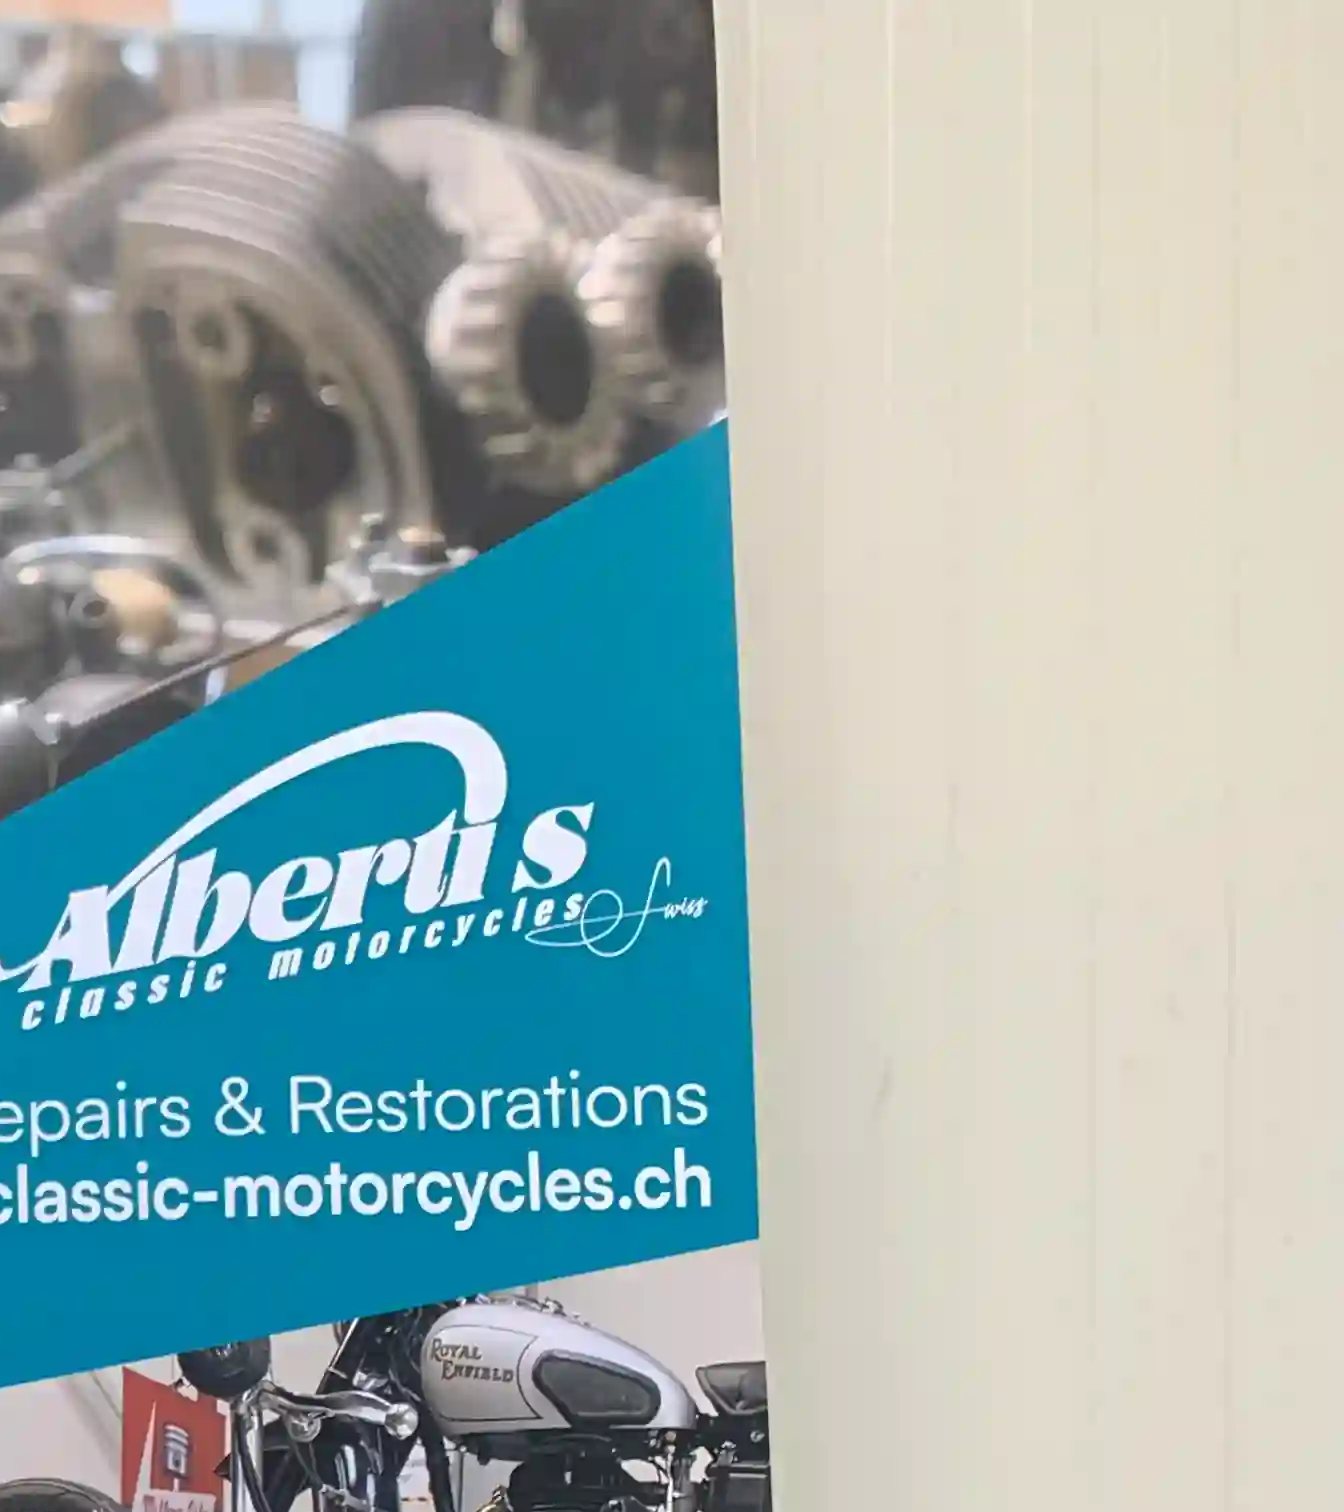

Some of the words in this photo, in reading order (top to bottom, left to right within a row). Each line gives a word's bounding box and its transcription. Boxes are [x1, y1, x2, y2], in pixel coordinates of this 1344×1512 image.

[22, 964, 226, 1031] classic
[268, 893, 584, 980] motorcycles
[215, 1077, 264, 1136] &
[290, 1070, 708, 1134] Restorations
[431, 1338, 483, 1362] ROYAL
